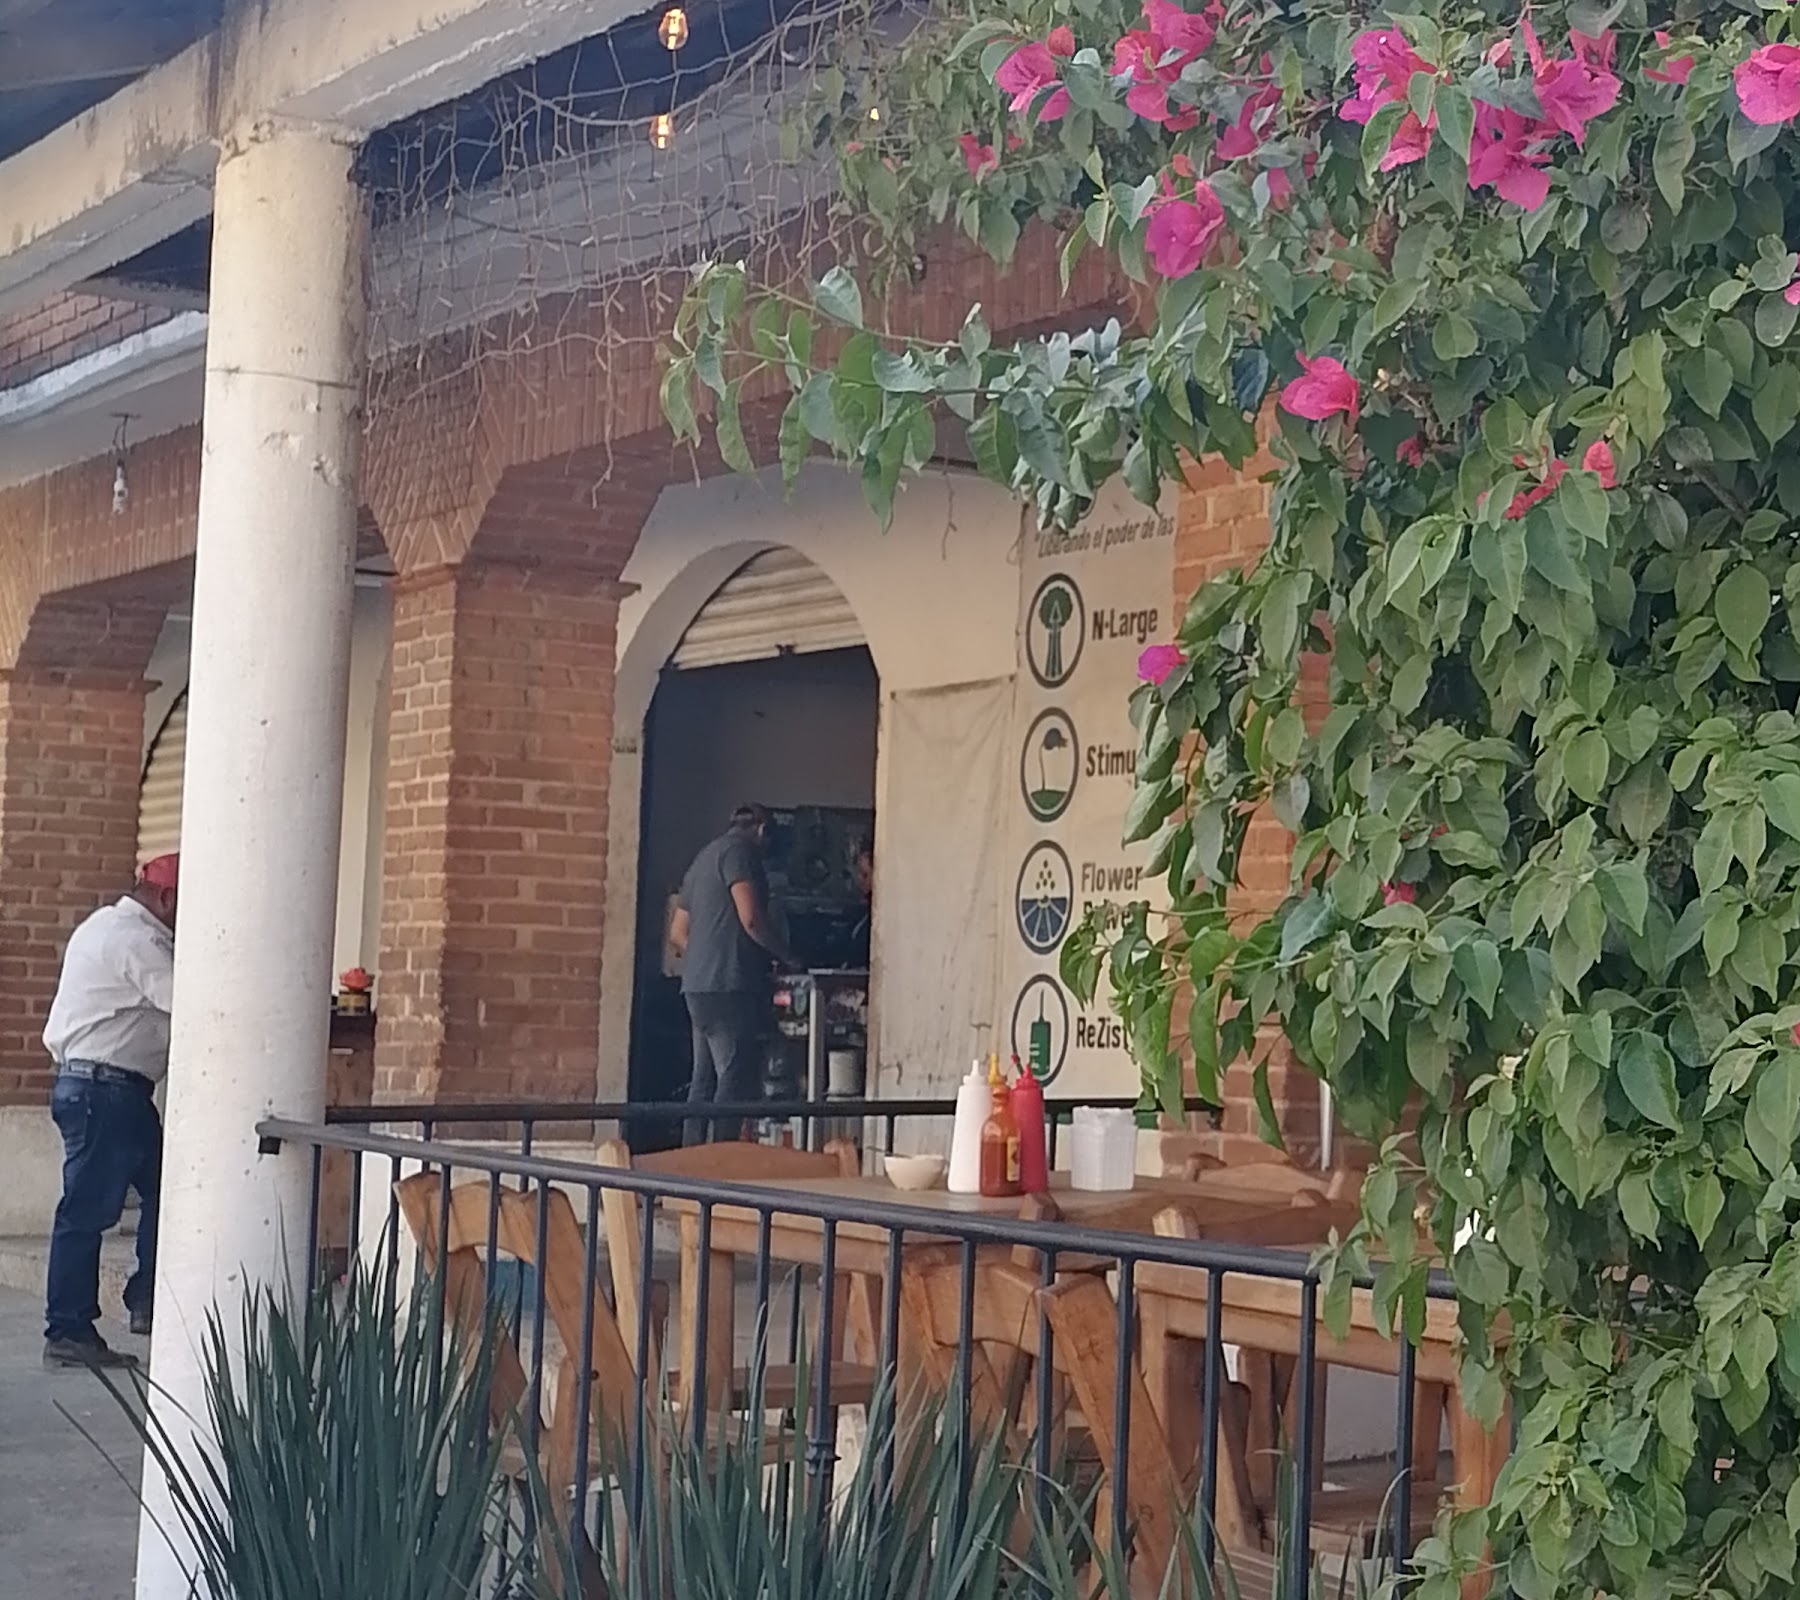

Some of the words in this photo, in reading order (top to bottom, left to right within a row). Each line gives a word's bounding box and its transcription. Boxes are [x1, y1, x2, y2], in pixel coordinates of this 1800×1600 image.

[1092, 522, 1105, 549] el
[1103, 518, 1141, 555] poder
[1140, 514, 1156, 540] de
[1081, 862, 1144, 893] Flower
